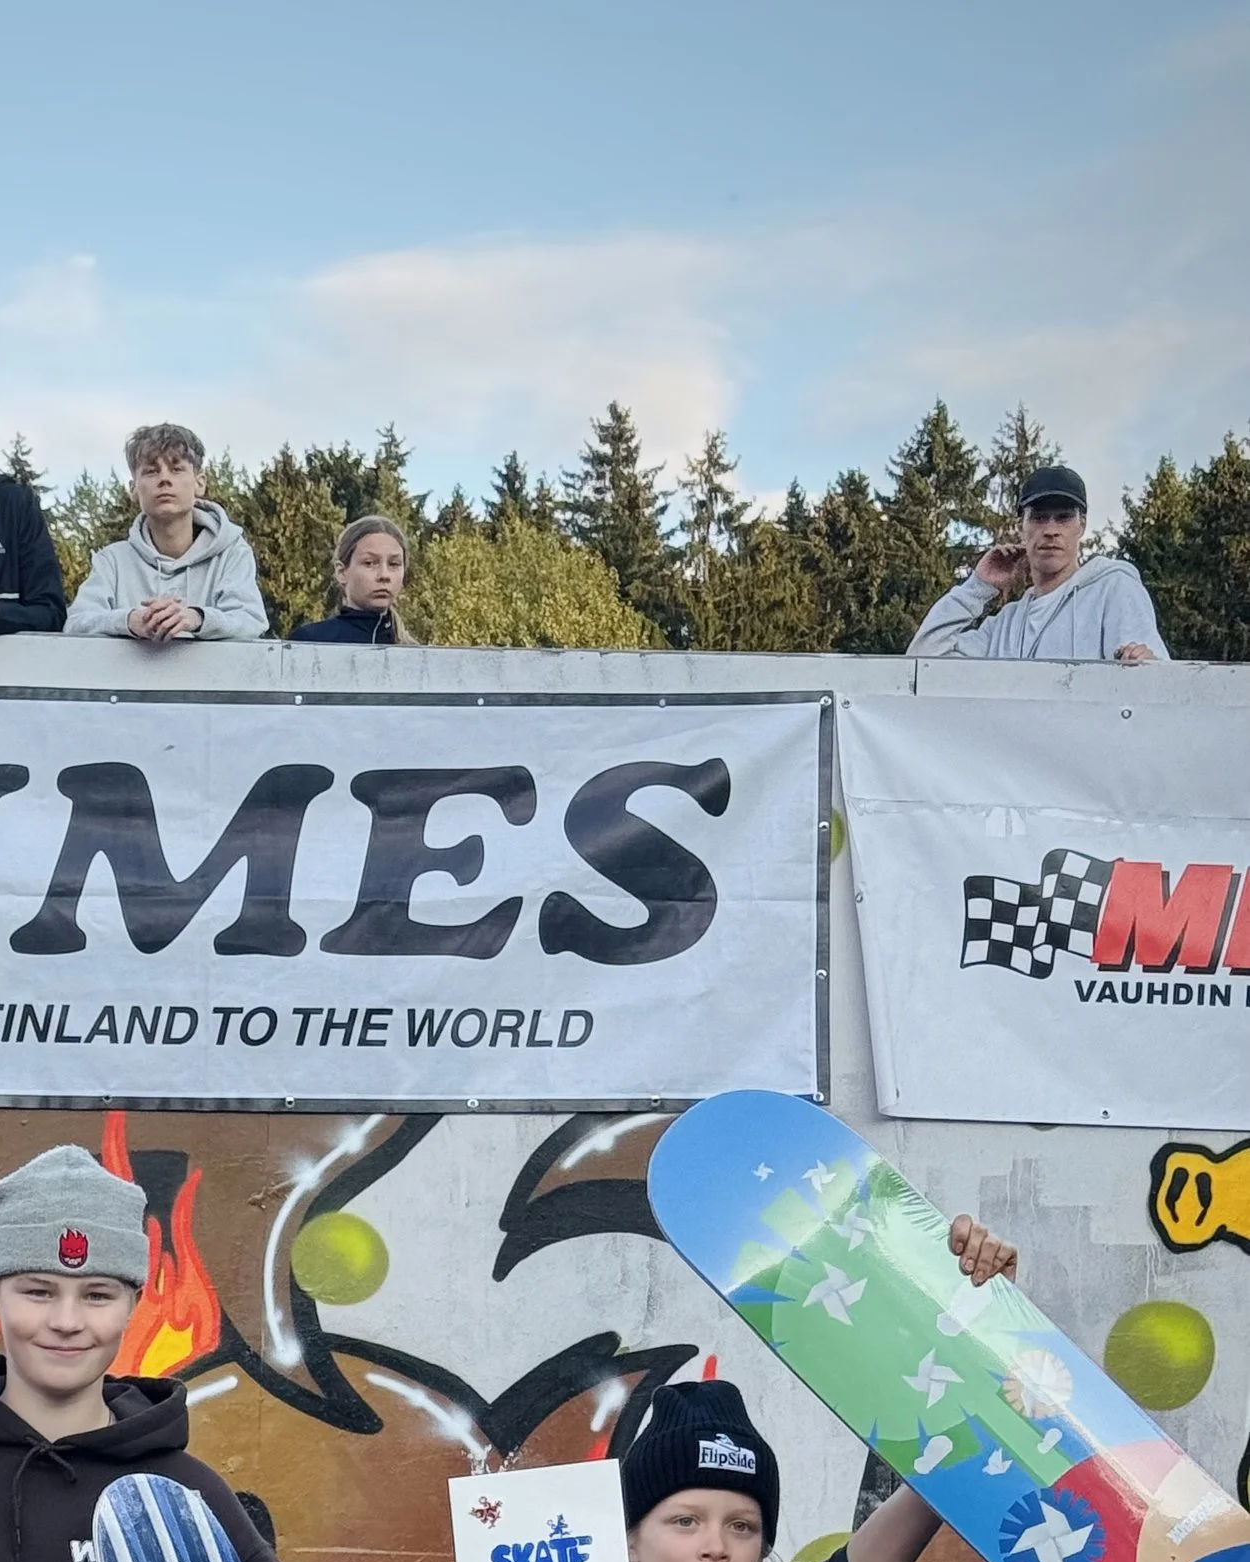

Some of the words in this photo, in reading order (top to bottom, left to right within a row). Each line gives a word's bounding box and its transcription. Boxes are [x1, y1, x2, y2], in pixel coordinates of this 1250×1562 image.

[1073, 979, 1232, 1007] VAUHDIN
[213, 1005, 279, 1047] TO
[294, 1006, 400, 1048] THE
[406, 1008, 594, 1049] WORLD
[700, 1446, 756, 1470] FlipSide
